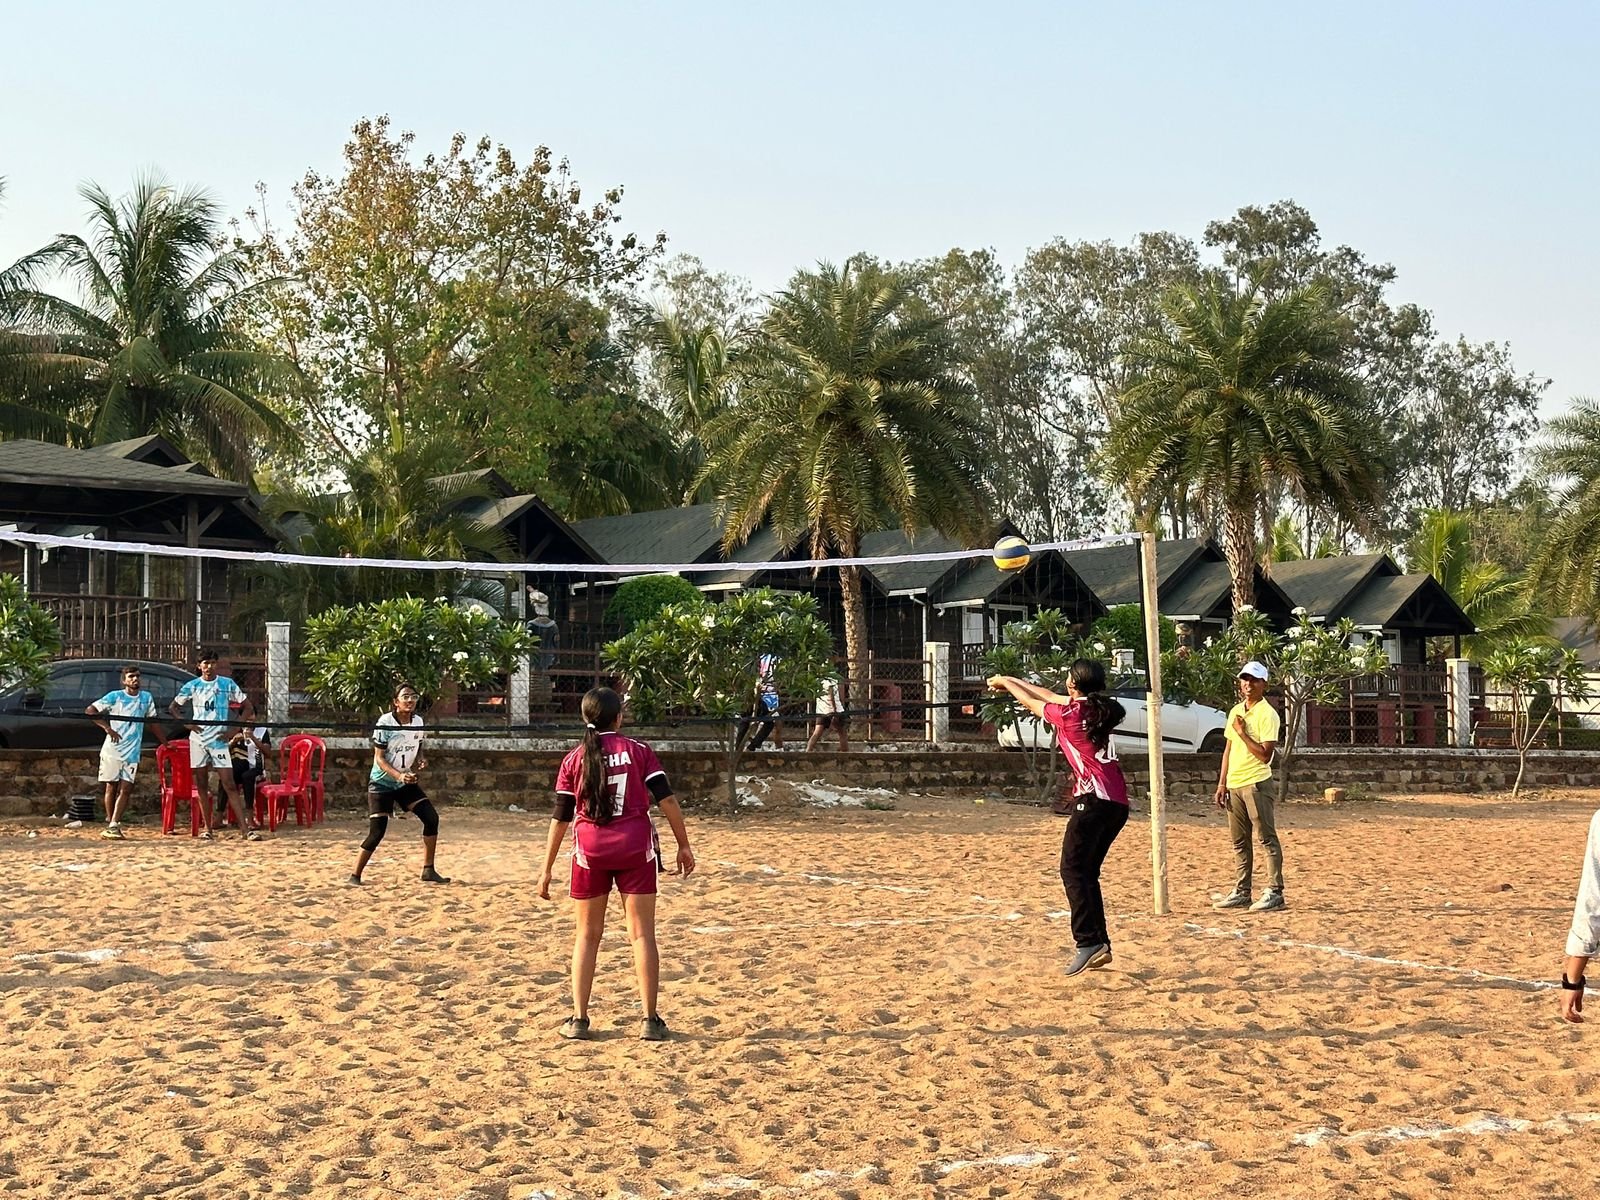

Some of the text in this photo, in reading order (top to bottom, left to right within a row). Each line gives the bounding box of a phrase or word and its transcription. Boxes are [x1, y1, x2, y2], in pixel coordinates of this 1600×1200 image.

[204, 700, 215, 711] 04
[401, 754, 405, 768] 1
[607, 772, 627, 816] 7
